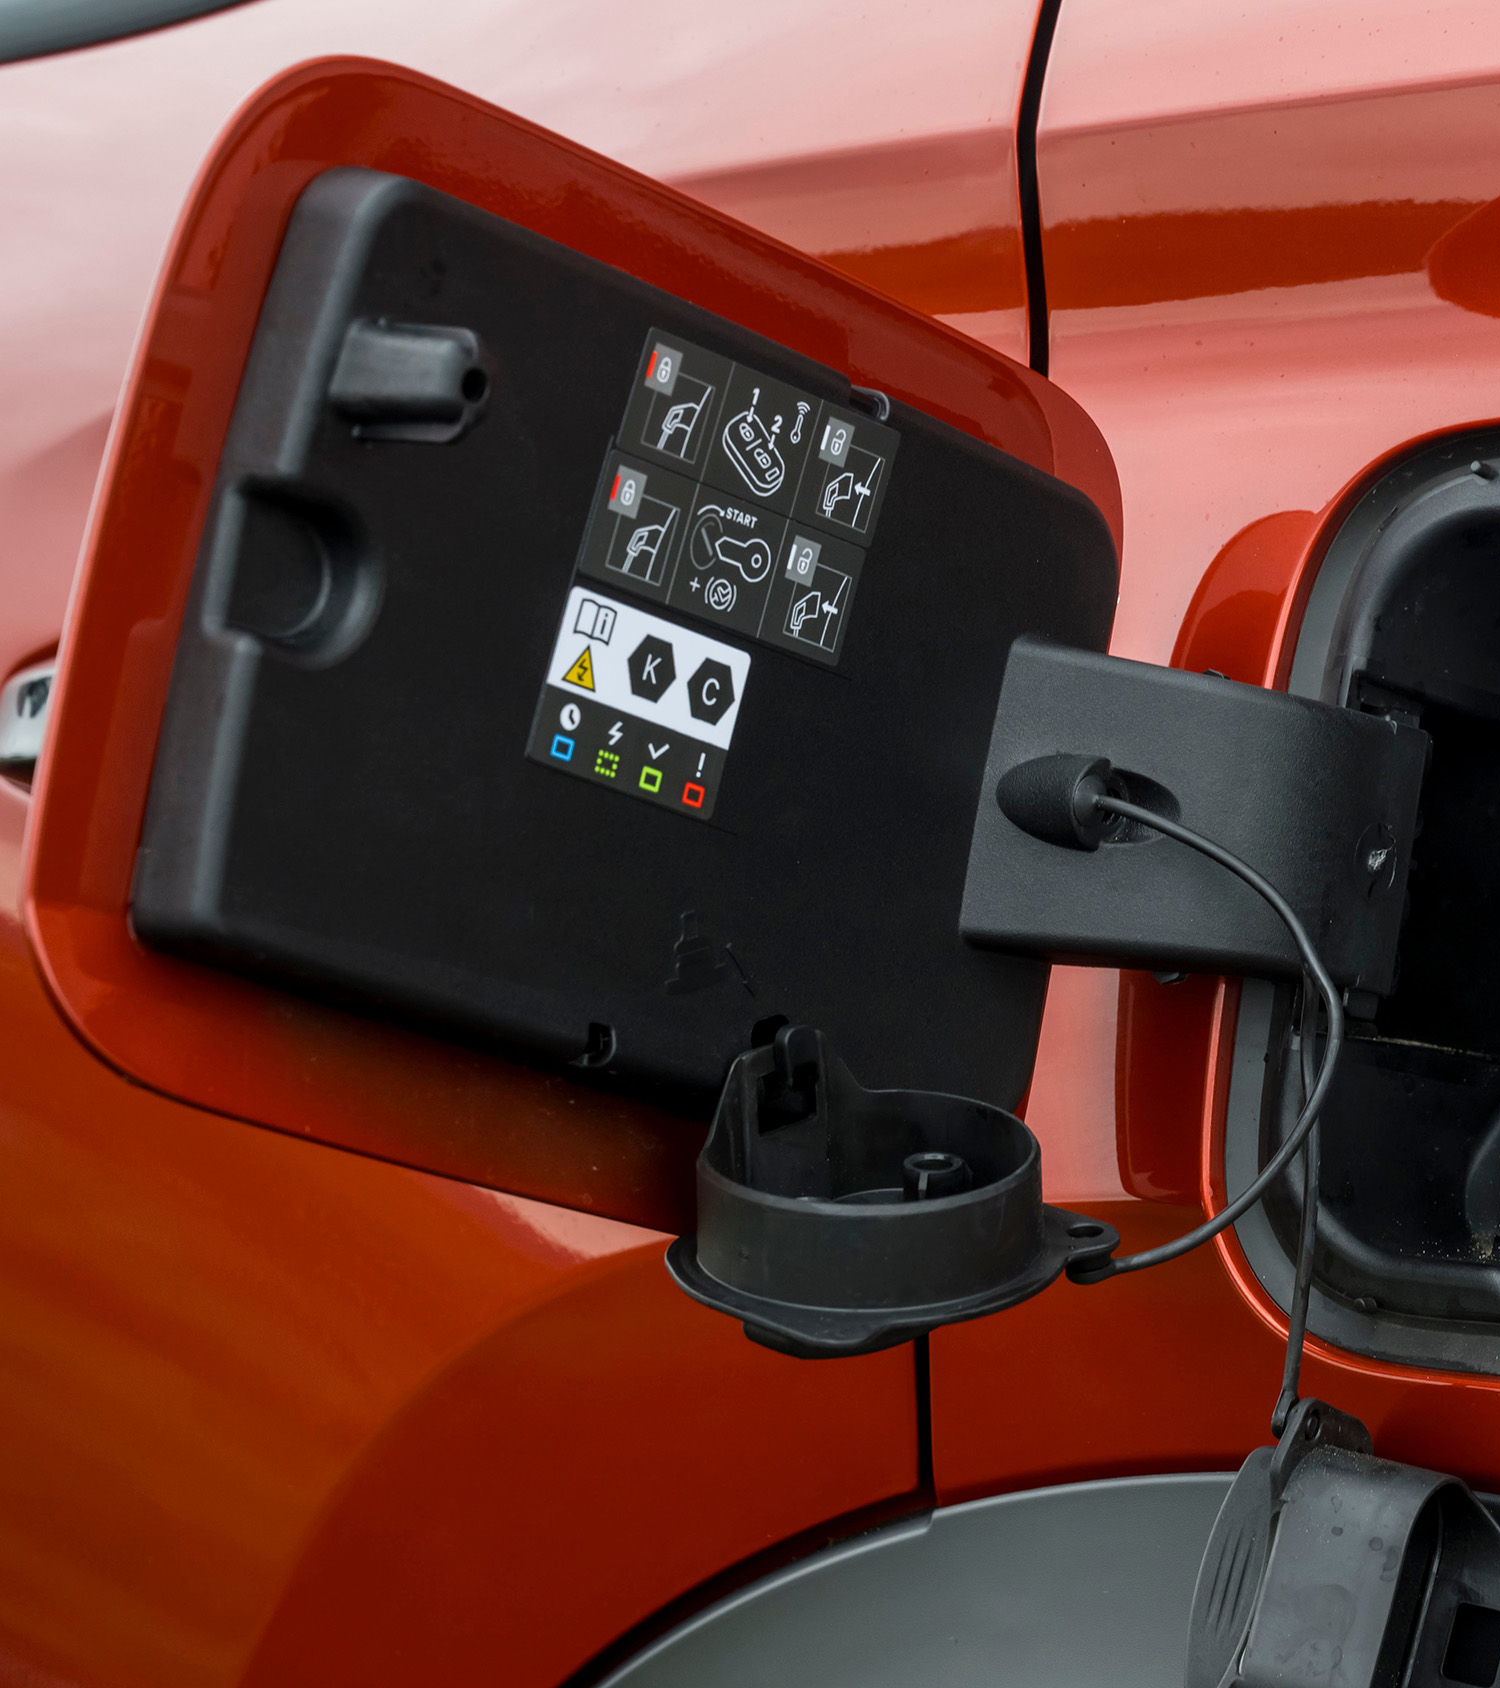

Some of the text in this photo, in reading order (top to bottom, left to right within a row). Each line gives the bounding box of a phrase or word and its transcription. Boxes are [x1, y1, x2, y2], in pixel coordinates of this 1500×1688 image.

[752, 388, 760, 405] 1
[771, 415, 783, 433] 2
[725, 507, 758, 528] START
[642, 654, 662, 684] K
[702, 678, 720, 705] C
